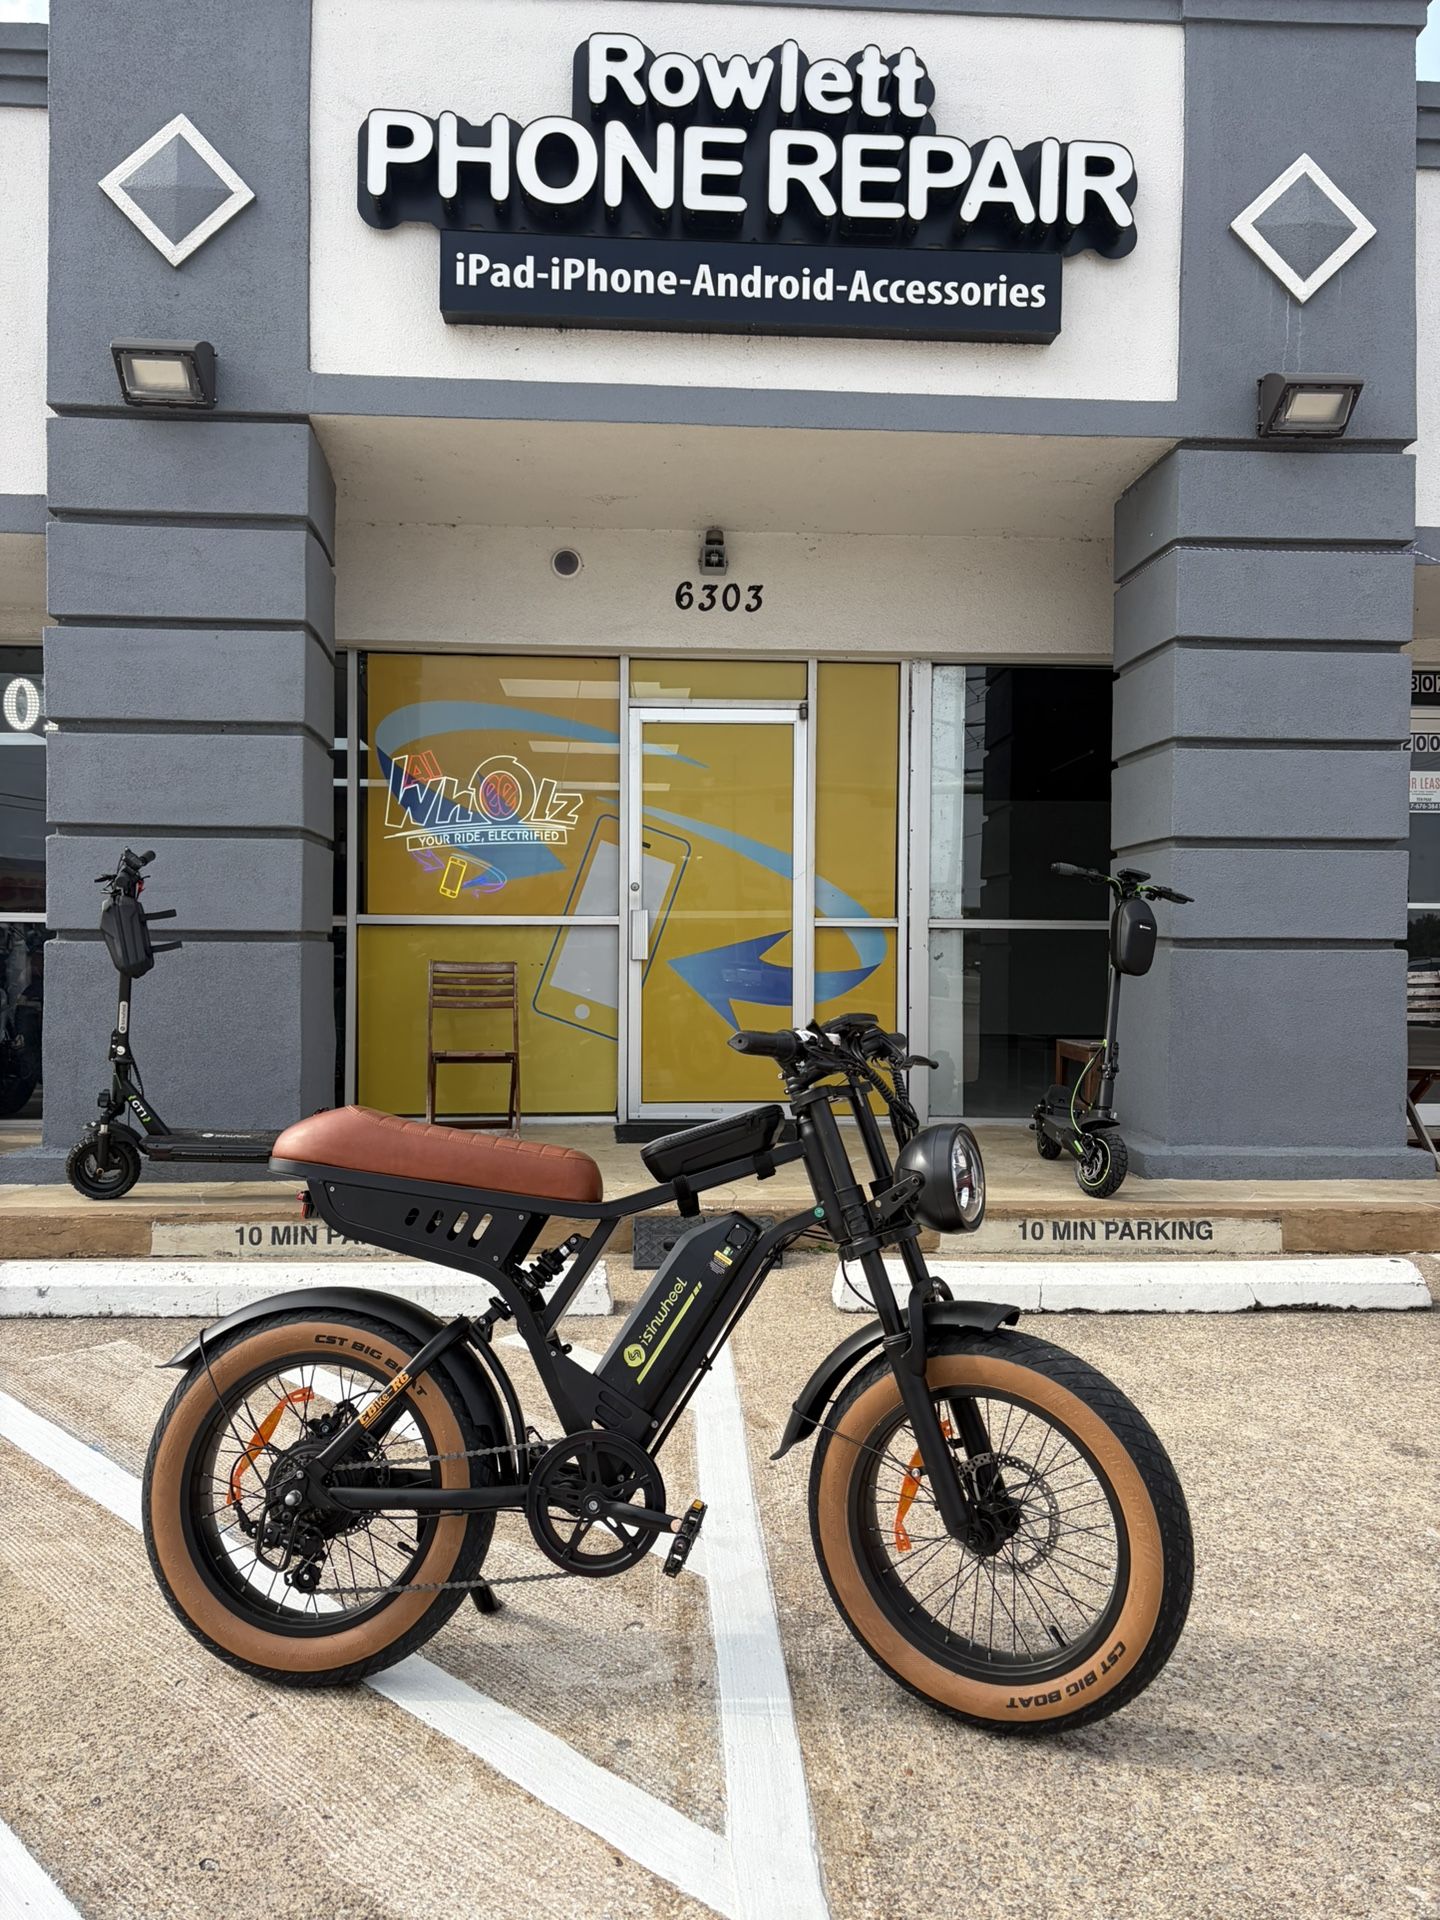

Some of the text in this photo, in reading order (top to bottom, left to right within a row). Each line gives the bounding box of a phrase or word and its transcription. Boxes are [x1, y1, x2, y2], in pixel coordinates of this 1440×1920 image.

[587, 33, 927, 118] Rowlett
[367, 109, 1135, 229] PHONE REPAIR
[675, 581, 763, 612] 6303
[419, 830, 559, 847] YOUR RIDE, ELECTRIFIED
[131, 1100, 147, 1117] GT1
[235, 1226, 263, 1246] 10
[271, 1225, 318, 1246] MIN
[1018, 1220, 1213, 1241] 10 MIN PARKING
[639, 1277, 688, 1346] isinwheel
[315, 1334, 348, 1346] CST
[351, 1340, 383, 1360] BIG
[1006, 1641, 1126, 1709] CST BIG BOAT
